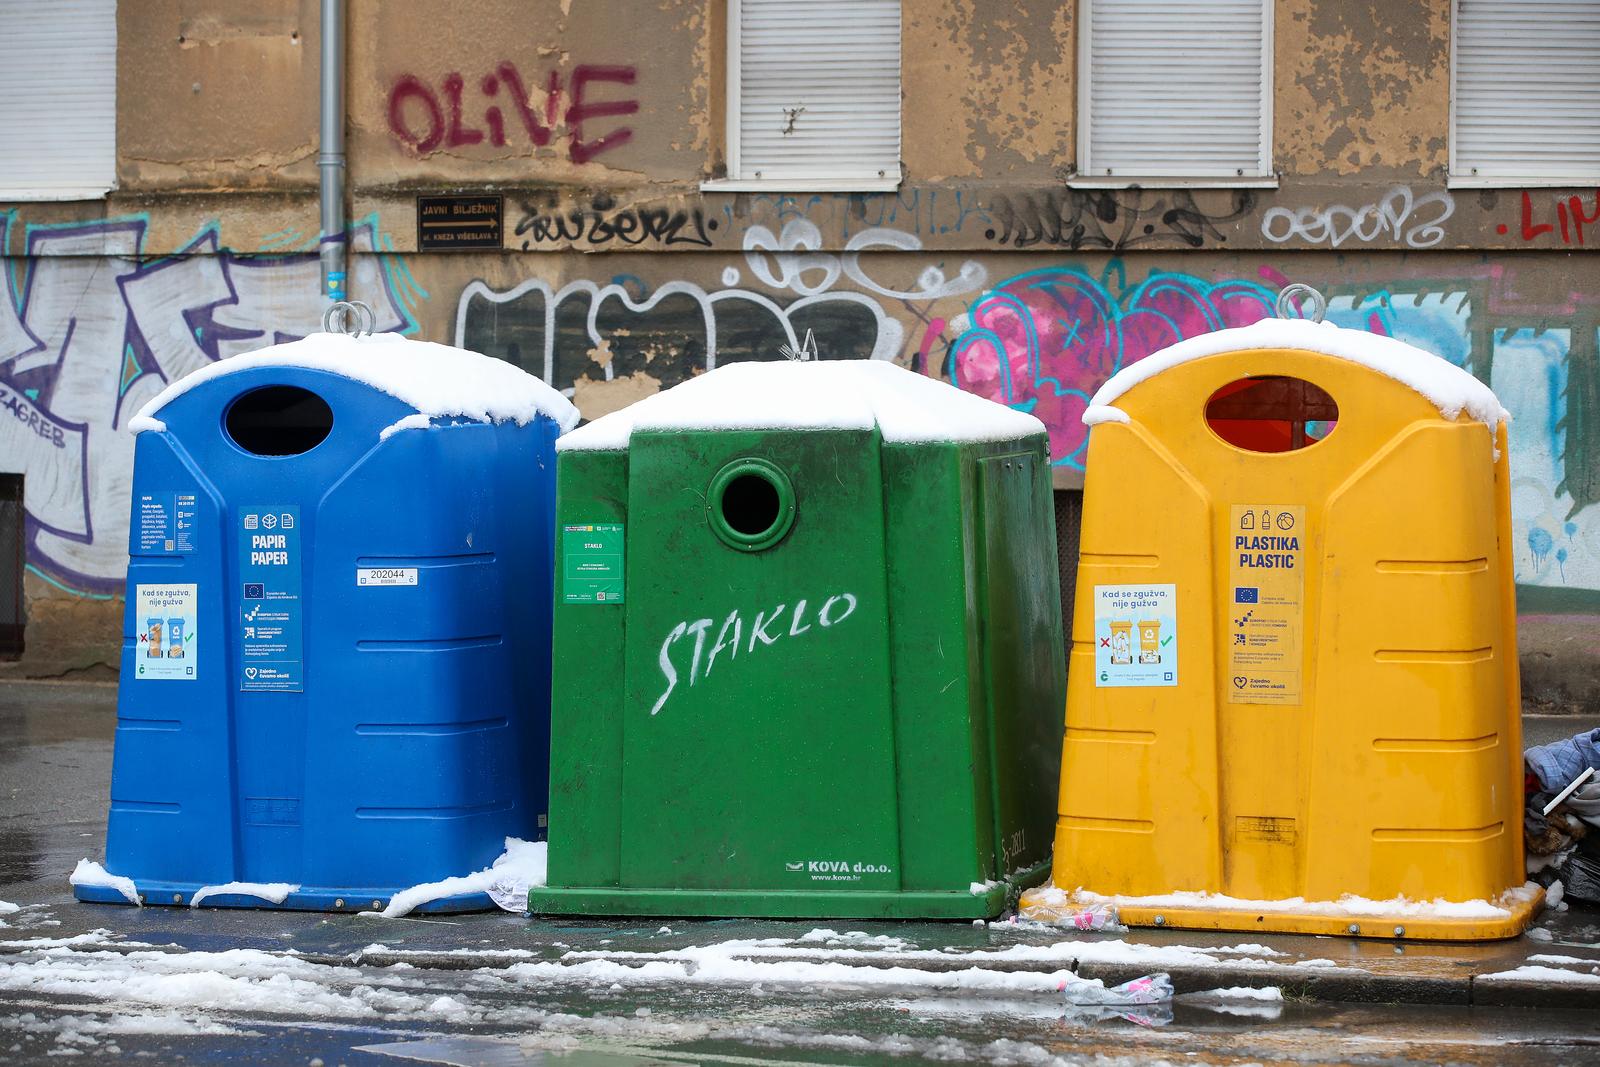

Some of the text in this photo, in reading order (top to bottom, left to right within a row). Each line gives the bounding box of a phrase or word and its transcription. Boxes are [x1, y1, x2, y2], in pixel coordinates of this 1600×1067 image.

[423, 203, 497, 215] JAVNI BILJEŽNIK
[457, 231, 492, 240] VIŠESLAVA
[252, 535, 286, 549] PAPIR
[1235, 536, 1299, 551] PLASTIKA
[251, 551, 288, 565] PAPER
[1240, 553, 1294, 568] PLASTIC
[371, 570, 404, 579] 202044
[165, 589, 191, 598] zgužva,
[1133, 590, 1168, 599] zgužva,
[149, 598, 183, 607] nije gužva
[1112, 600, 1158, 609] nije gužva
[651, 593, 857, 715] STAKLO
[808, 861, 892, 873] KOVA d.o.o.
